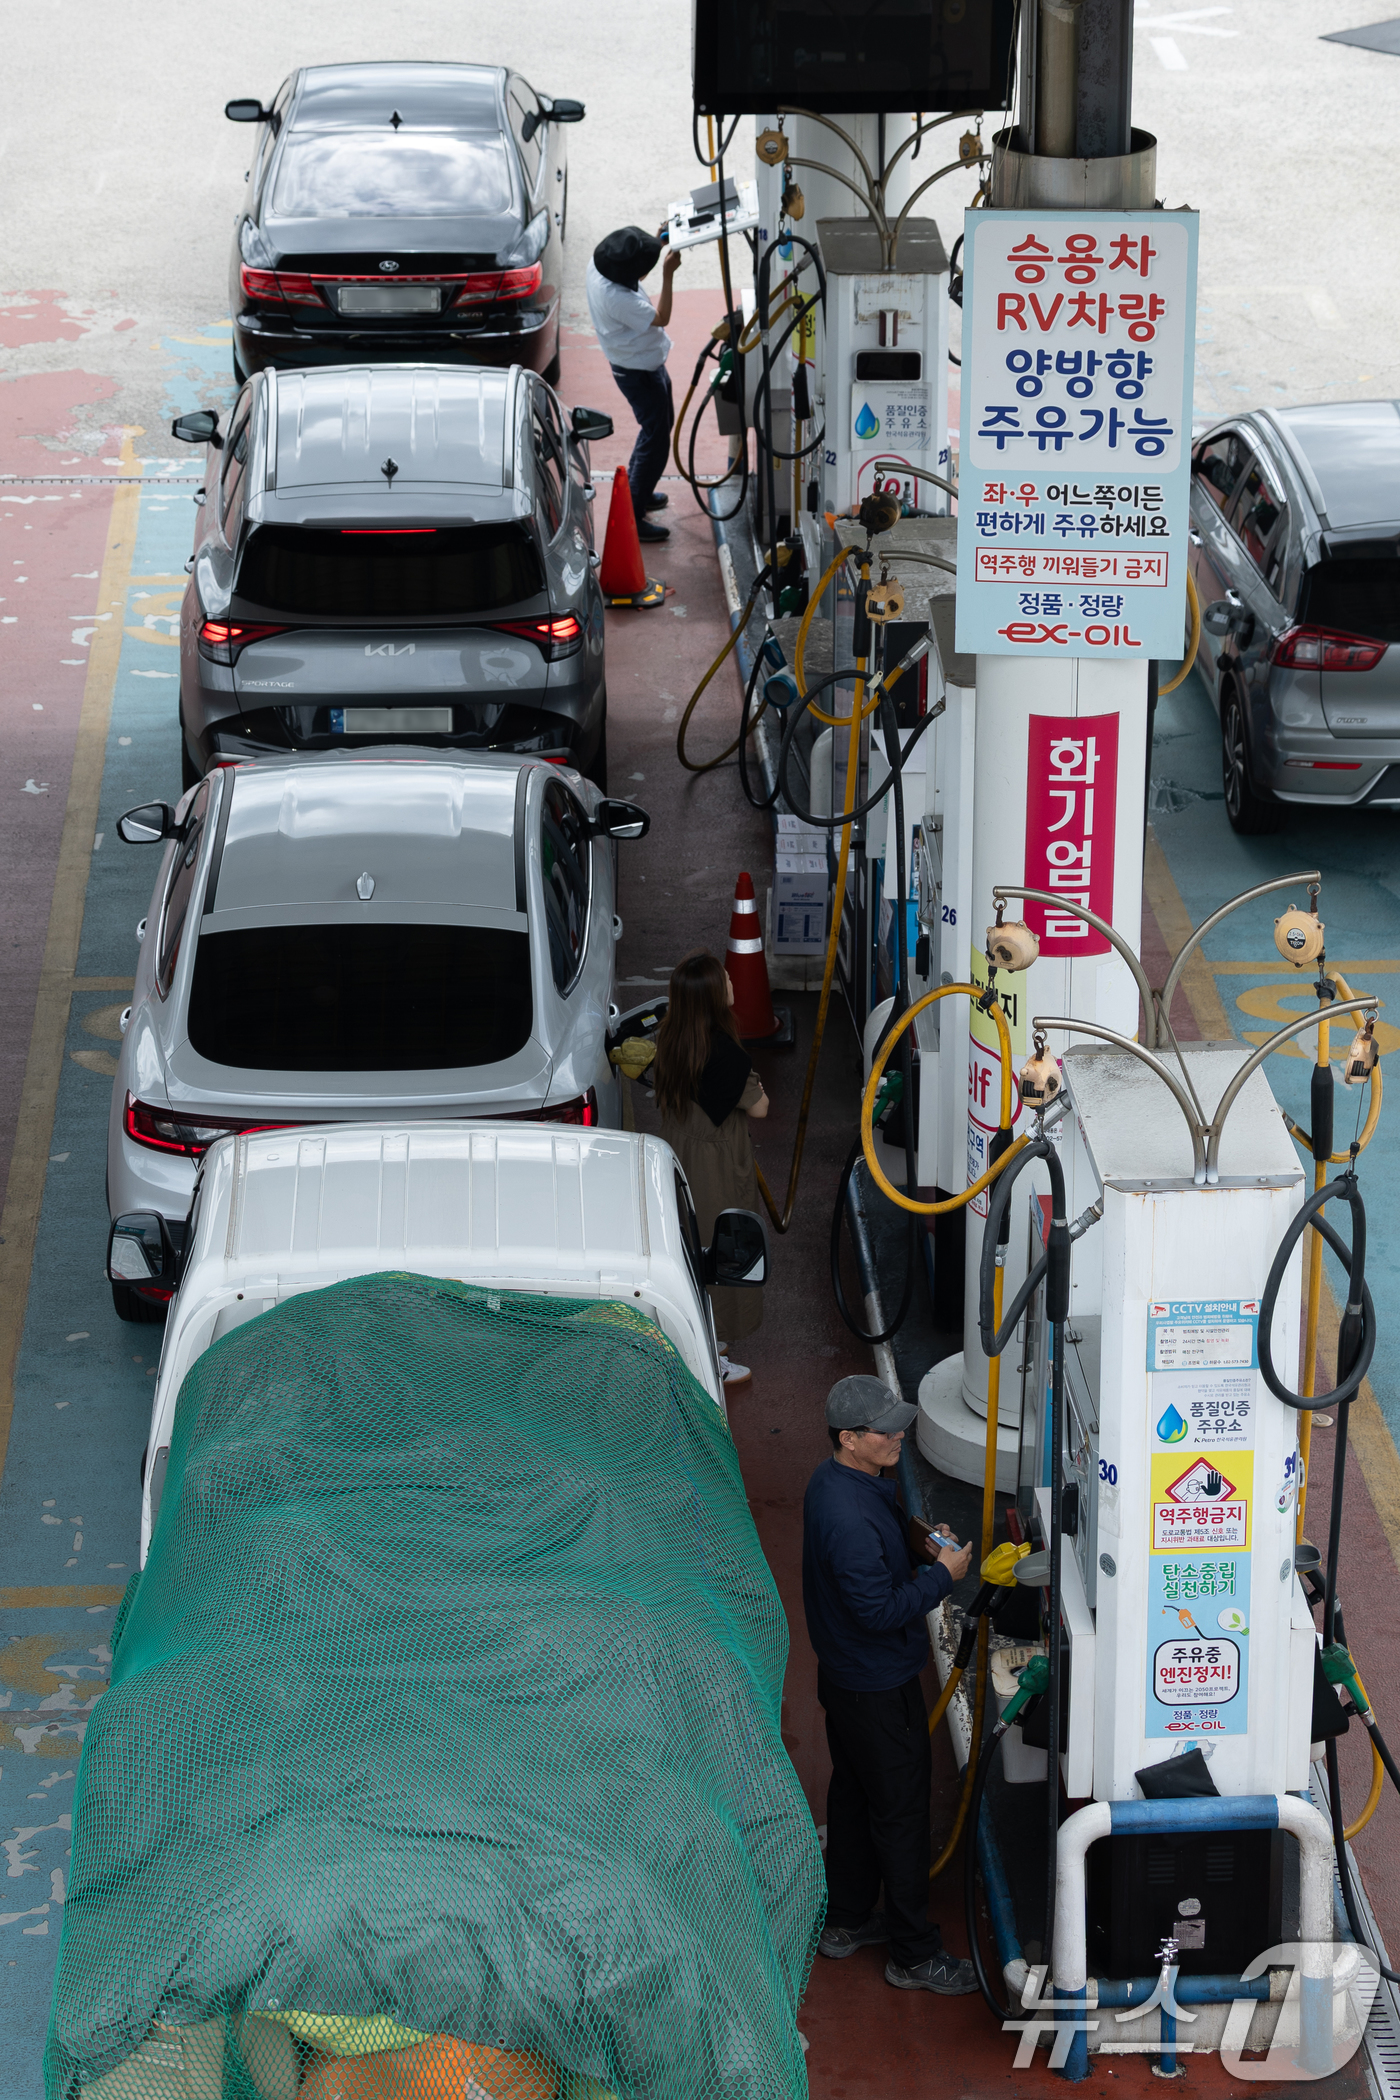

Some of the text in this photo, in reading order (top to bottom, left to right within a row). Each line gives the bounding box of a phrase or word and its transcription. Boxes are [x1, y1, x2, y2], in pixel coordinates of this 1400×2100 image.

[1007, 233, 1157, 285] 승용차
[996, 291, 1166, 343] RV차량
[1005, 348, 1153, 400] 양방향
[885, 405, 928, 417] 품질인증
[977, 405, 1174, 457] 주유가능
[825, 450, 837, 466] 22
[938, 448, 948, 466] 23
[1046, 484, 1164, 511] 어느쪽이든
[976, 512, 1170, 538] 편하게 주유하세요
[980, 555, 1161, 579] 역주행 끼워들기 금지
[364, 643, 416, 656] KIA
[241, 680, 295, 688] SPORTAGE
[1044, 736, 1101, 938] 화기엄금
[941, 905, 957, 926] 26
[1172, 1302, 1237, 1314] CCTV 설치안내
[1189, 1400, 1251, 1418] 품질인증
[1197, 1419, 1243, 1435] 주유소
[1098, 1458, 1118, 1486] 30
[1159, 1506, 1242, 1526] 역주행금지
[1162, 1528, 1192, 1536] 도로교통법
[1187, 1535, 1205, 1543] 과태료
[1162, 1561, 1237, 1582] 탄소중립
[1162, 1580, 1236, 1600] 실천하기
[1171, 1646, 1222, 1664] 주유중
[1160, 1665, 1231, 1684] 엔진정지!
